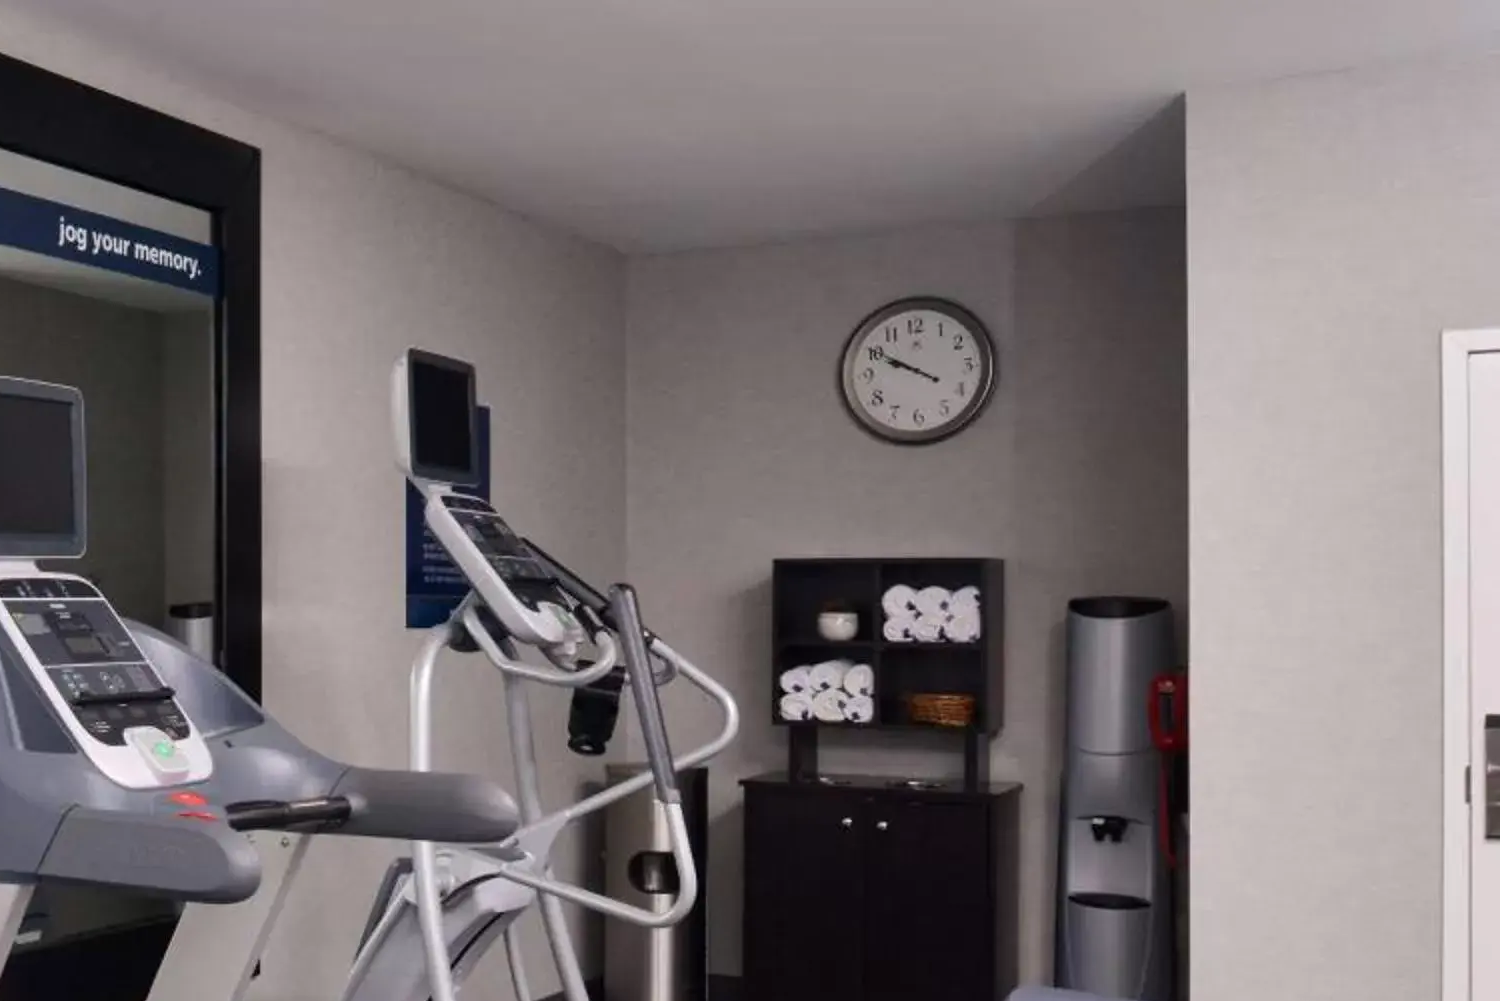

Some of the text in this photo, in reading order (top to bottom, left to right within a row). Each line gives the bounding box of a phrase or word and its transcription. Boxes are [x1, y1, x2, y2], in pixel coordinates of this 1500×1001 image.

[58, 216, 202, 280] jog your memory.
[885, 326, 897, 343] 11
[907, 318, 925, 335] 12
[953, 334, 964, 350] 2
[863, 367, 875, 385] 9
[871, 389, 884, 406] 8
[888, 404, 900, 422] 7
[912, 408, 925, 426] 6
